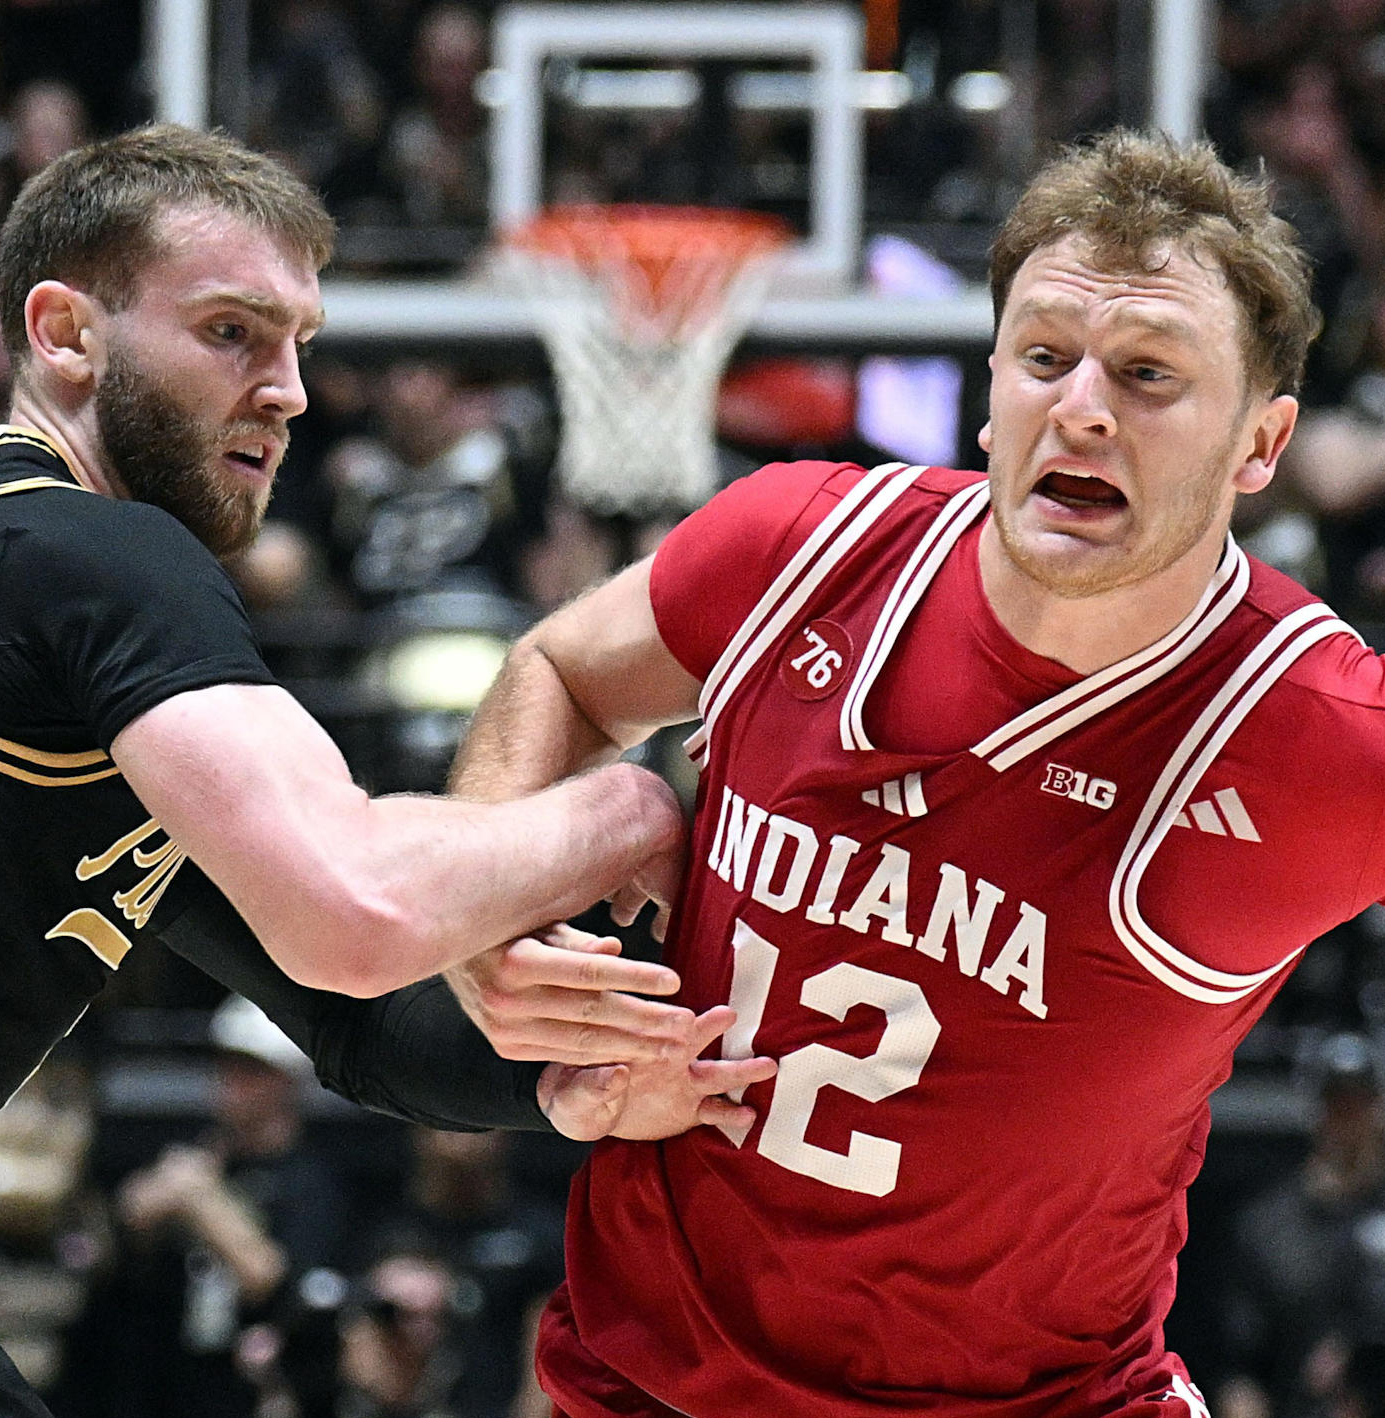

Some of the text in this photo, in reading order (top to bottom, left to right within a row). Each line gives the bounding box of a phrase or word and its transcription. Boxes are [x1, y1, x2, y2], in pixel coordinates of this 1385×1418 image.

[789, 626, 843, 690] '76
[707, 784, 1050, 1020] INDIANA
[714, 917, 943, 1198] 12
